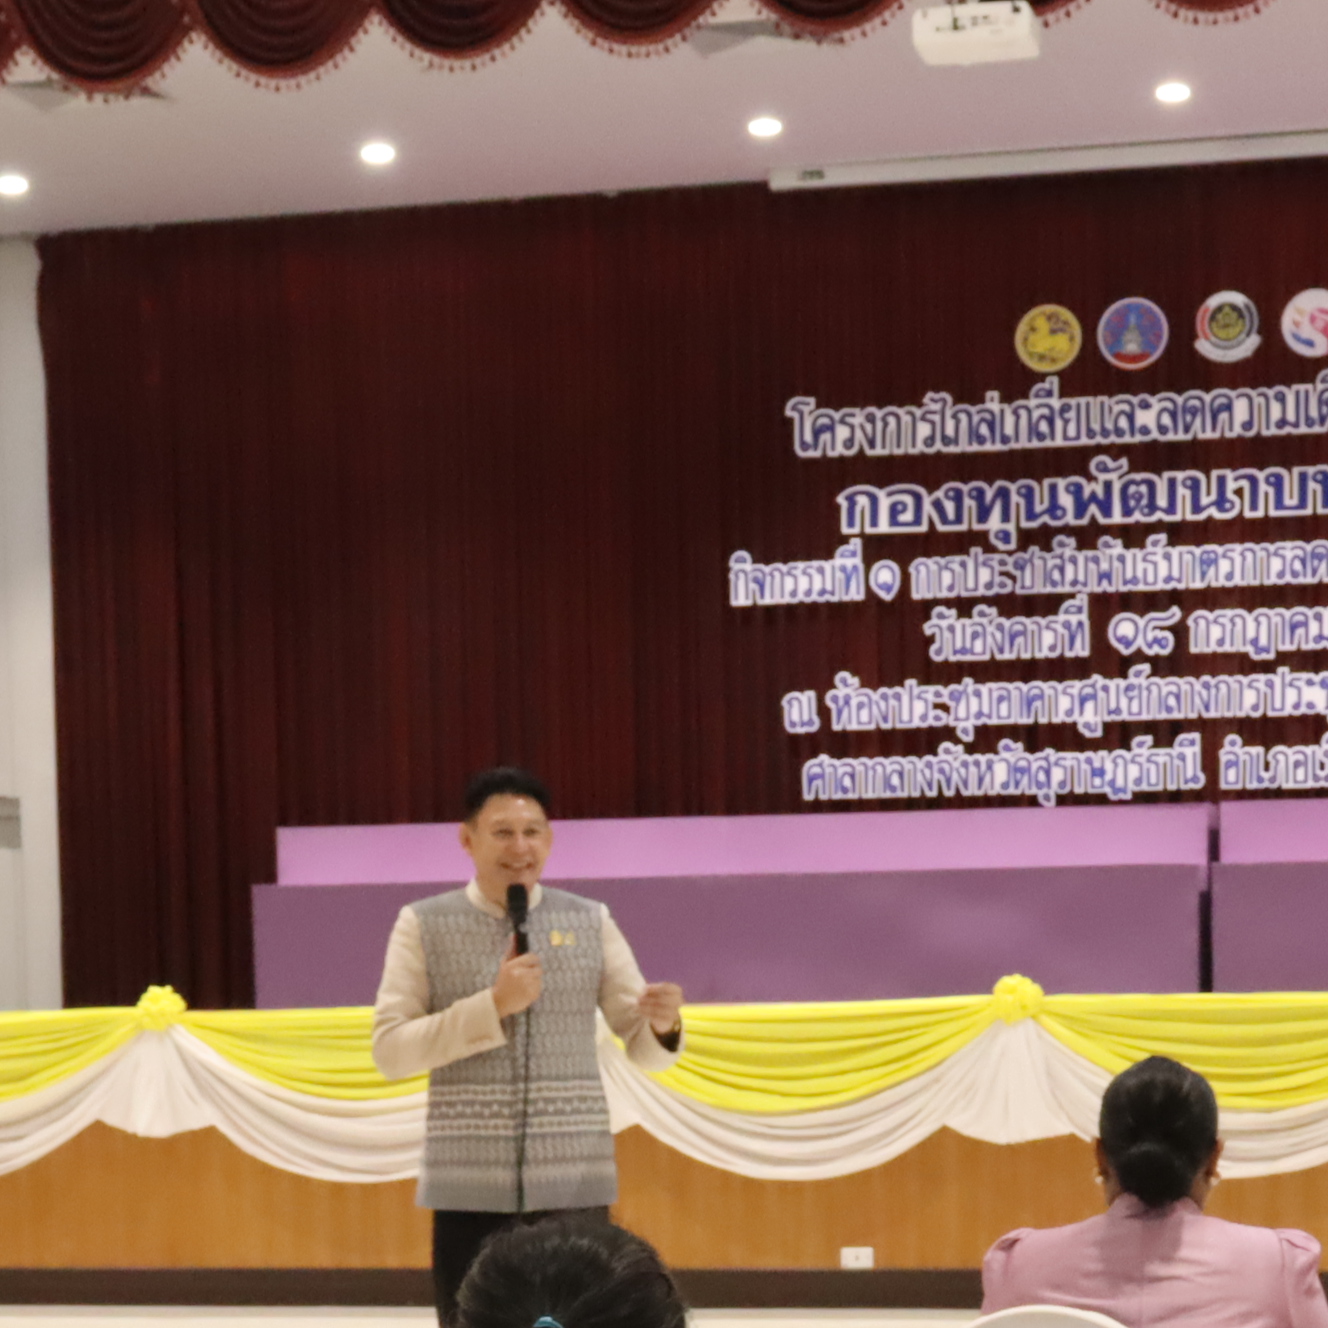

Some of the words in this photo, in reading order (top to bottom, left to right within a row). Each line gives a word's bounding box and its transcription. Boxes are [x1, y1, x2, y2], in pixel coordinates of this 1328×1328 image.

[729, 538, 865, 606] กิจกรรมที่
[869, 559, 901, 601] ๑
[924, 594, 1090, 661] วันอังคารที่
[1108, 606, 1182, 655] ๑๘
[782, 690, 820, 734] ณ
[803, 732, 1206, 807] ศาลากลางจังหวัดสุราษฎร์ธานี
